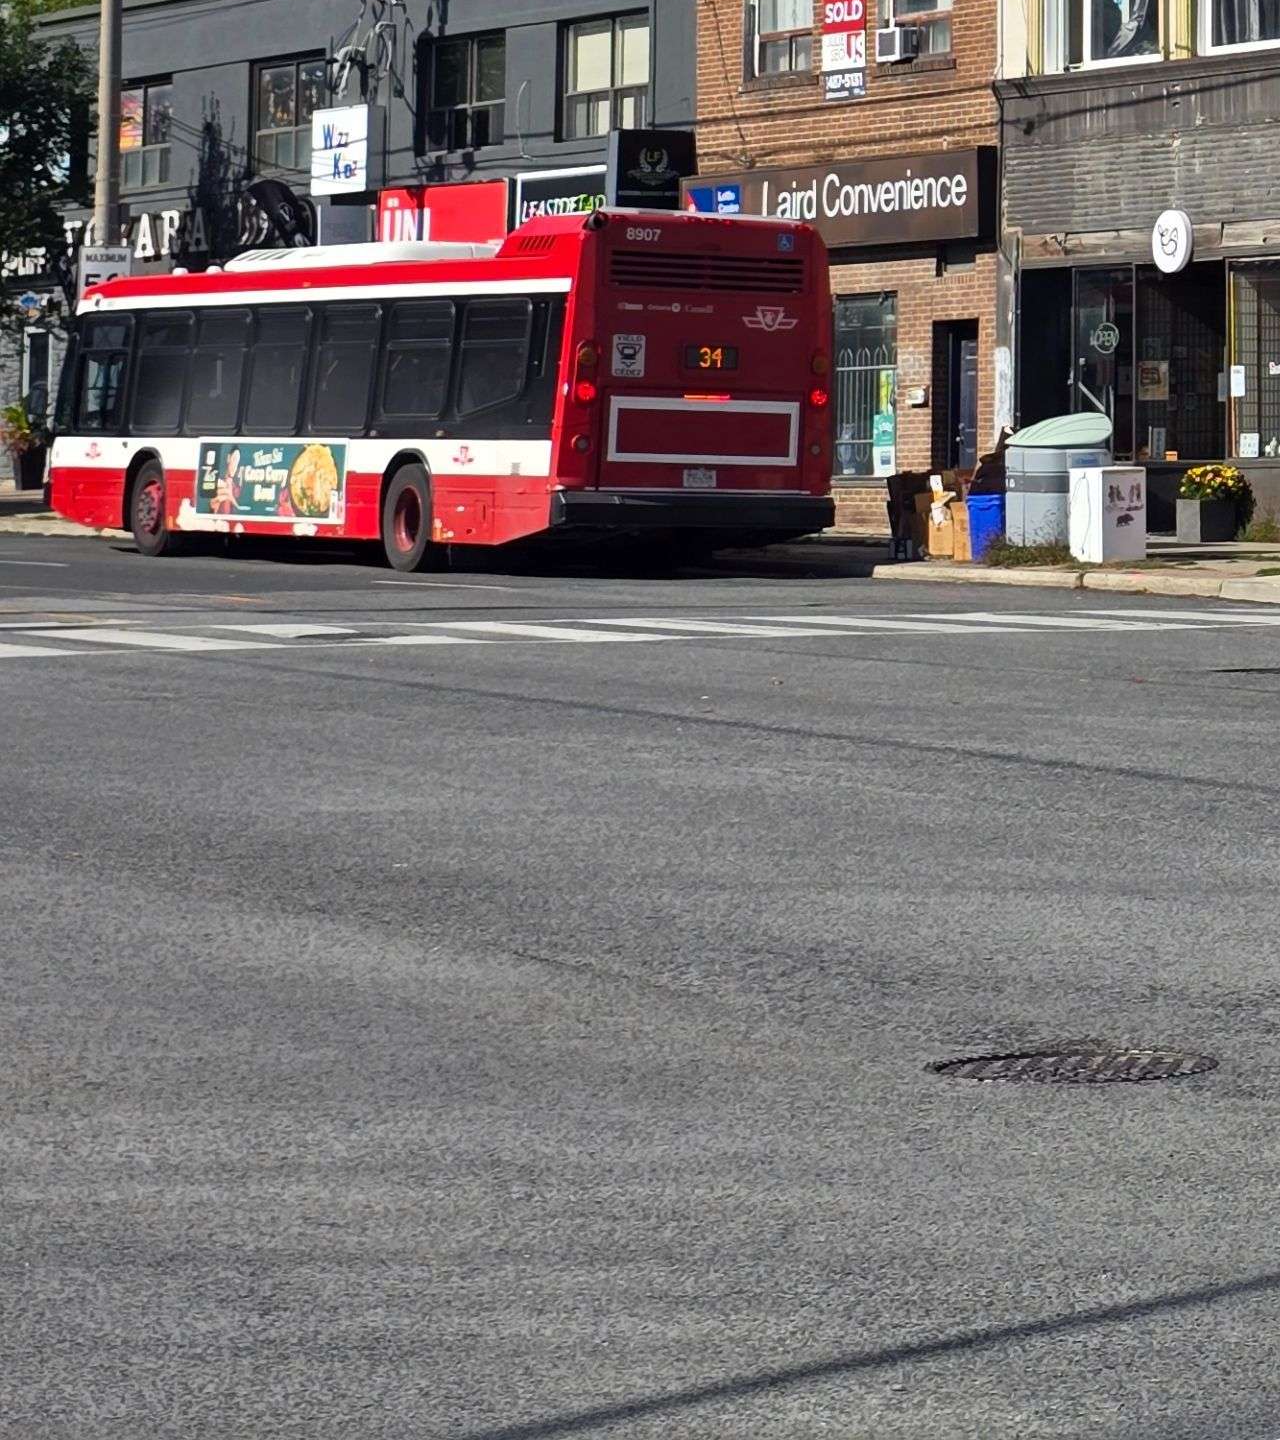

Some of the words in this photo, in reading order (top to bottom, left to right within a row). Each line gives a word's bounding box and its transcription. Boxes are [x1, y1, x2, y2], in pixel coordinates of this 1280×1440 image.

[824, 0, 863, 24] SOLD
[761, 179, 817, 220] Laird
[822, 169, 968, 218] Convenience
[626, 227, 662, 242] 8907
[85, 254, 128, 263] MAXIMUM
[699, 347, 723, 368] 34
